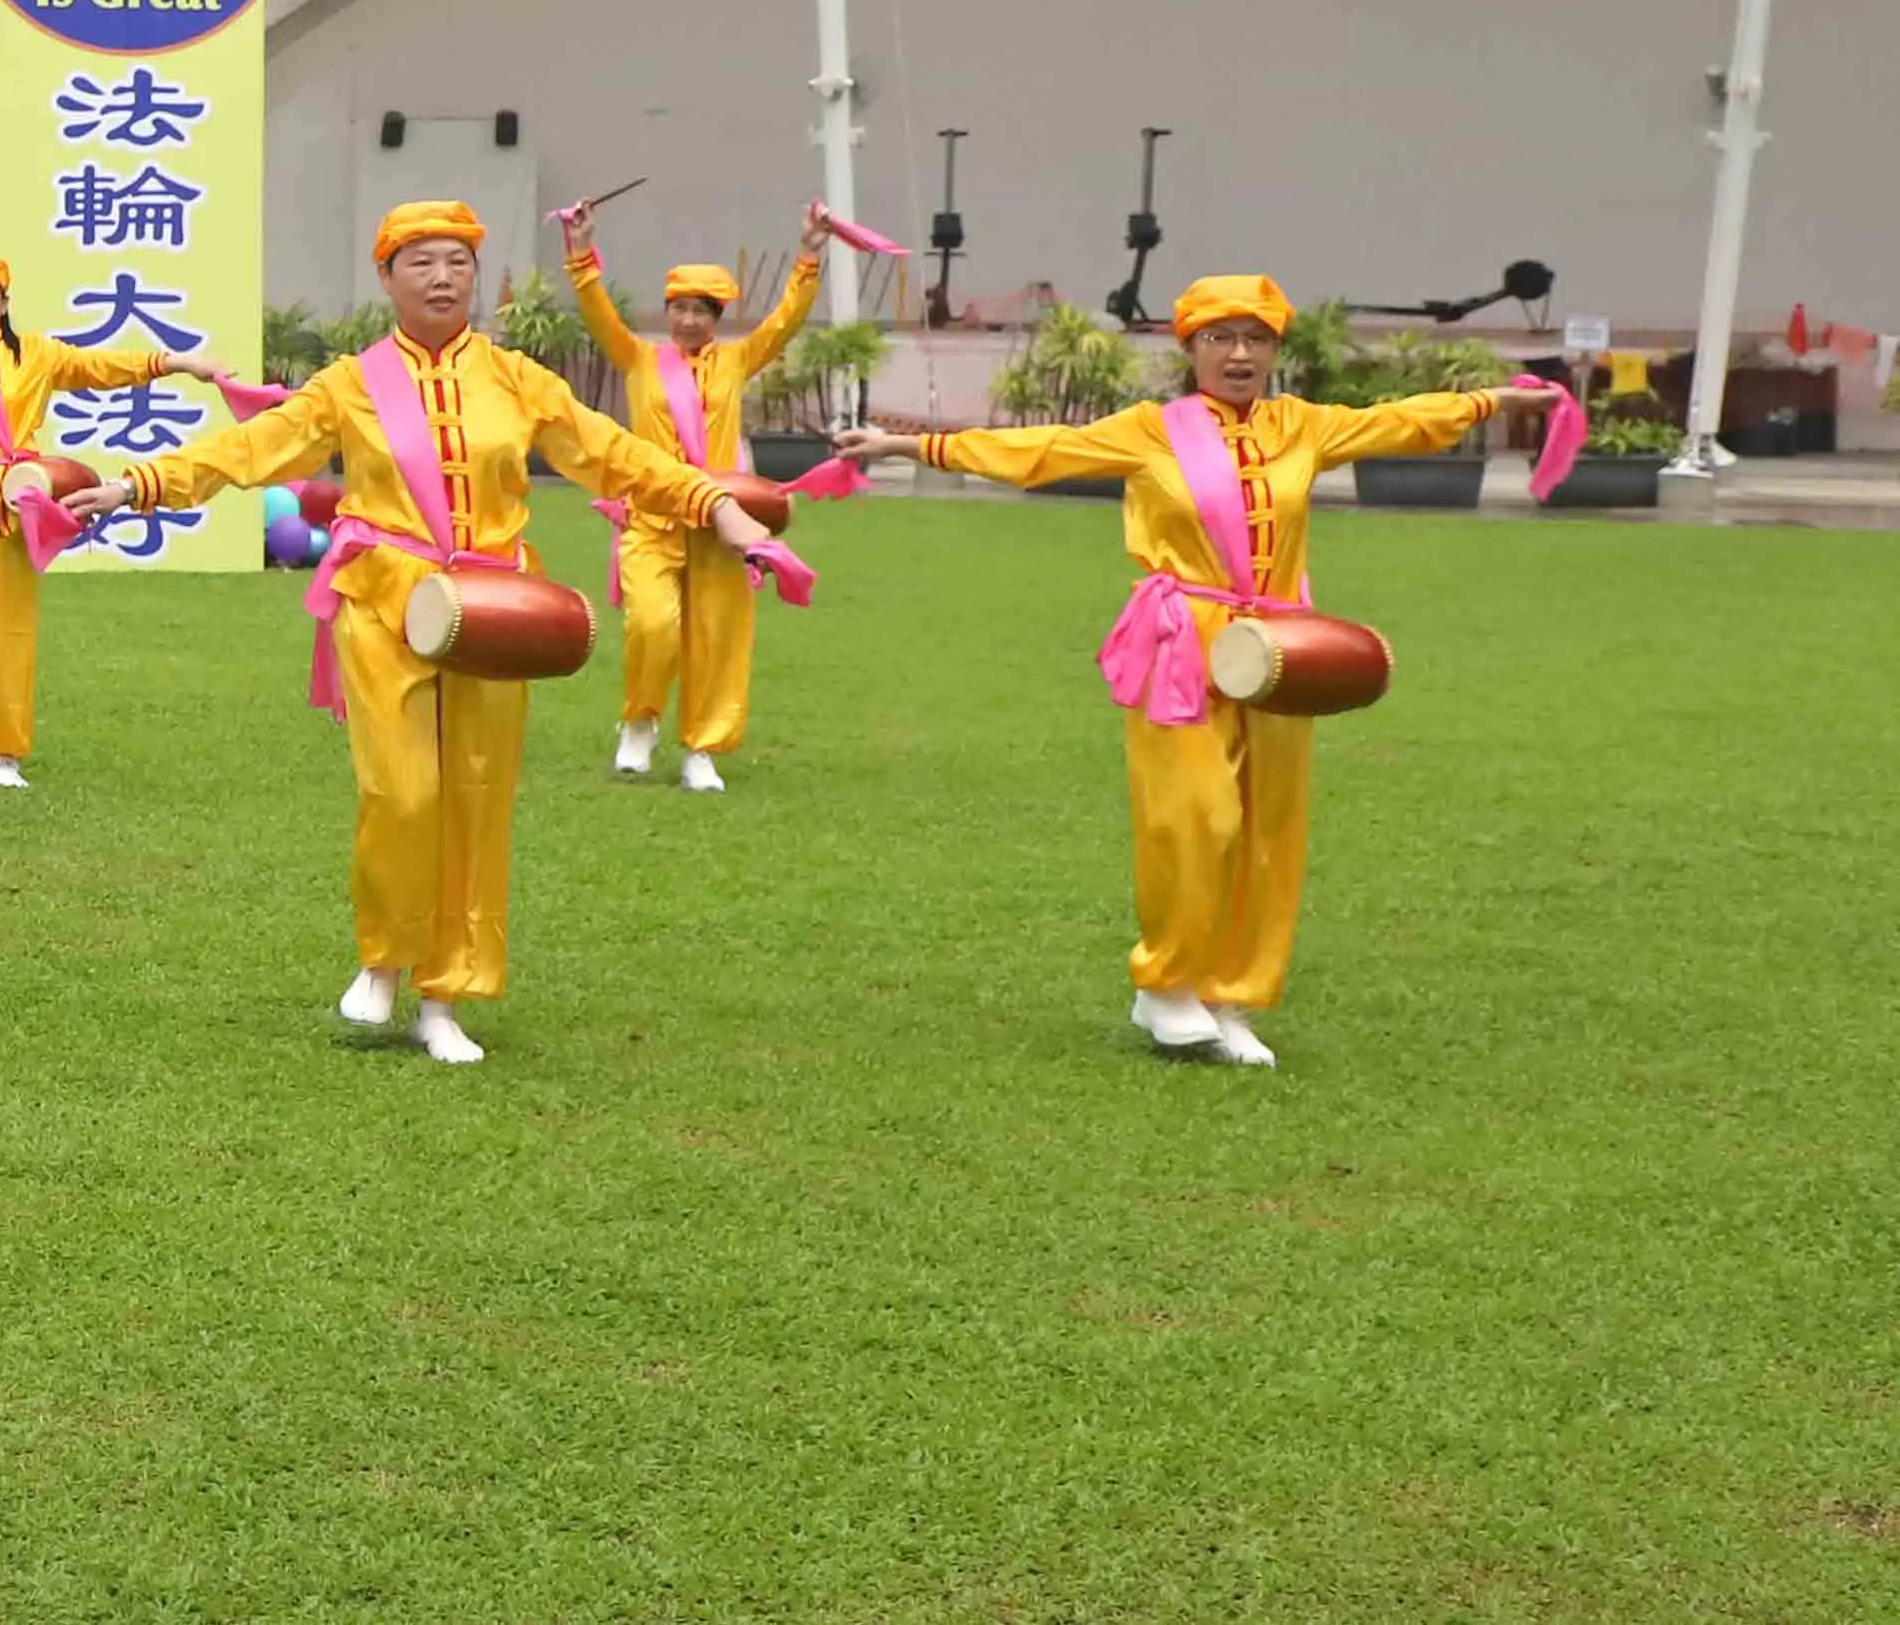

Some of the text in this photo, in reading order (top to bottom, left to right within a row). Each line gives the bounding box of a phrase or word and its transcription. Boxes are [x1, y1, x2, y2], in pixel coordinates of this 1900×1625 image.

[53, 68, 206, 558] 法輪大法好
